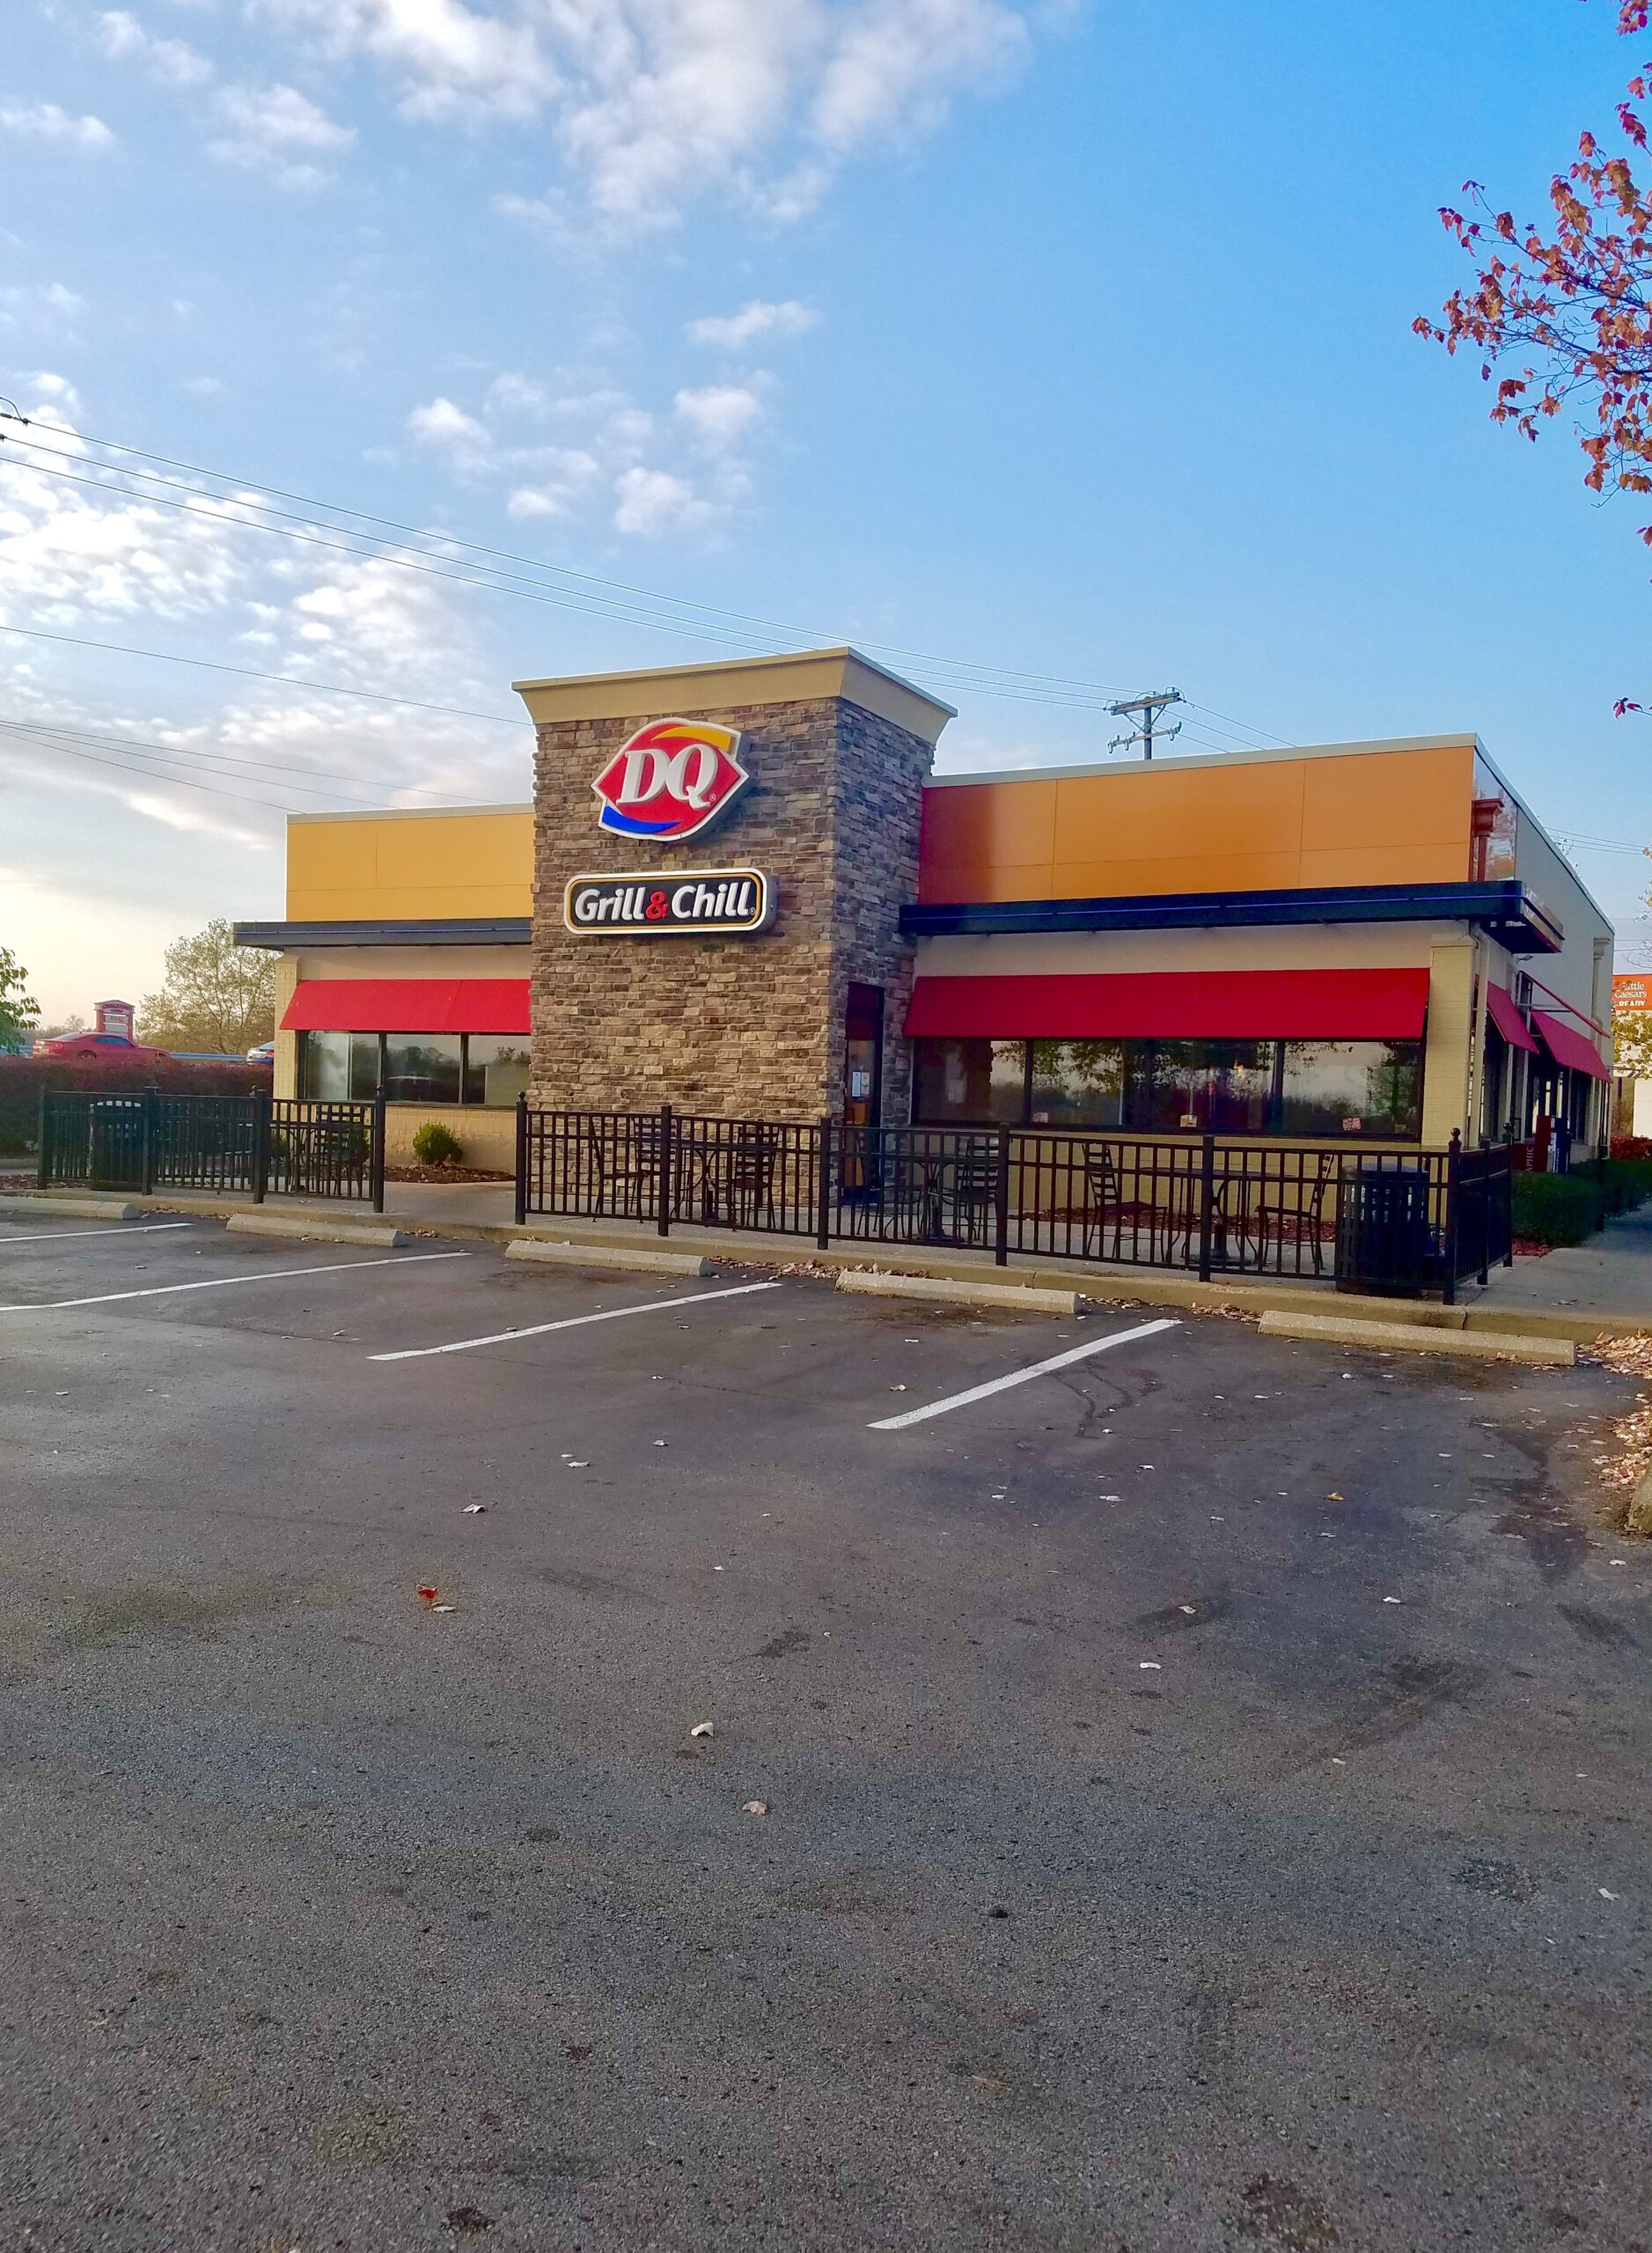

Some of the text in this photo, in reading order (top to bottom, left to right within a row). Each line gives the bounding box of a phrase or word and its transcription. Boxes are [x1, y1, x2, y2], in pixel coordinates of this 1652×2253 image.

[616, 744, 718, 809] DQ
[575, 881, 751, 921] Grill & Chill
[1614, 989, 1648, 999] Caesars
